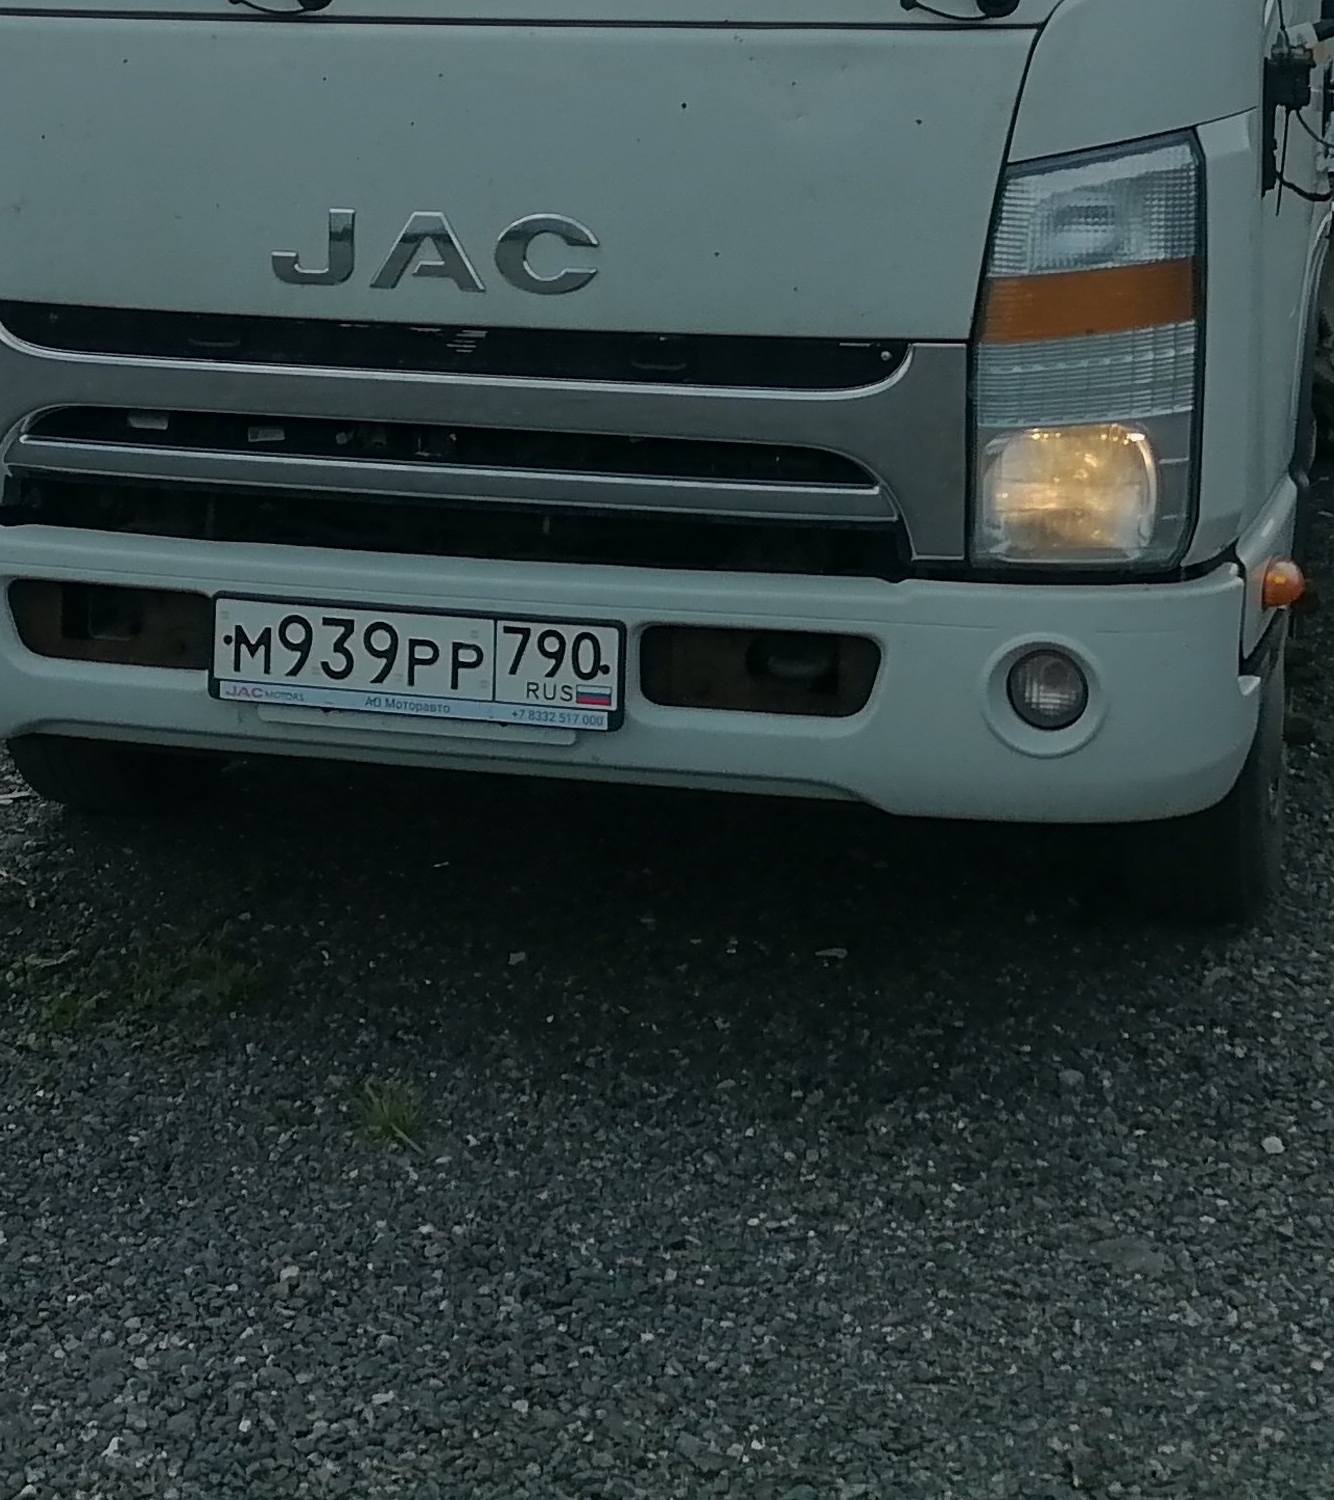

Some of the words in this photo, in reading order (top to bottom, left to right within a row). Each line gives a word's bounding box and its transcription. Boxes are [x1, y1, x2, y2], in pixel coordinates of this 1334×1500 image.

[271, 208, 599, 296] JAC
[503, 626, 602, 681] 790
[225, 685, 263, 699] JAC
[527, 682, 573, 702] RUS
[385, 698, 451, 714] Моторавто
[512, 709, 525, 719] +7
[528, 710, 556, 722] 8332
[559, 713, 579, 724] 517
[582, 714, 604, 727] 000
